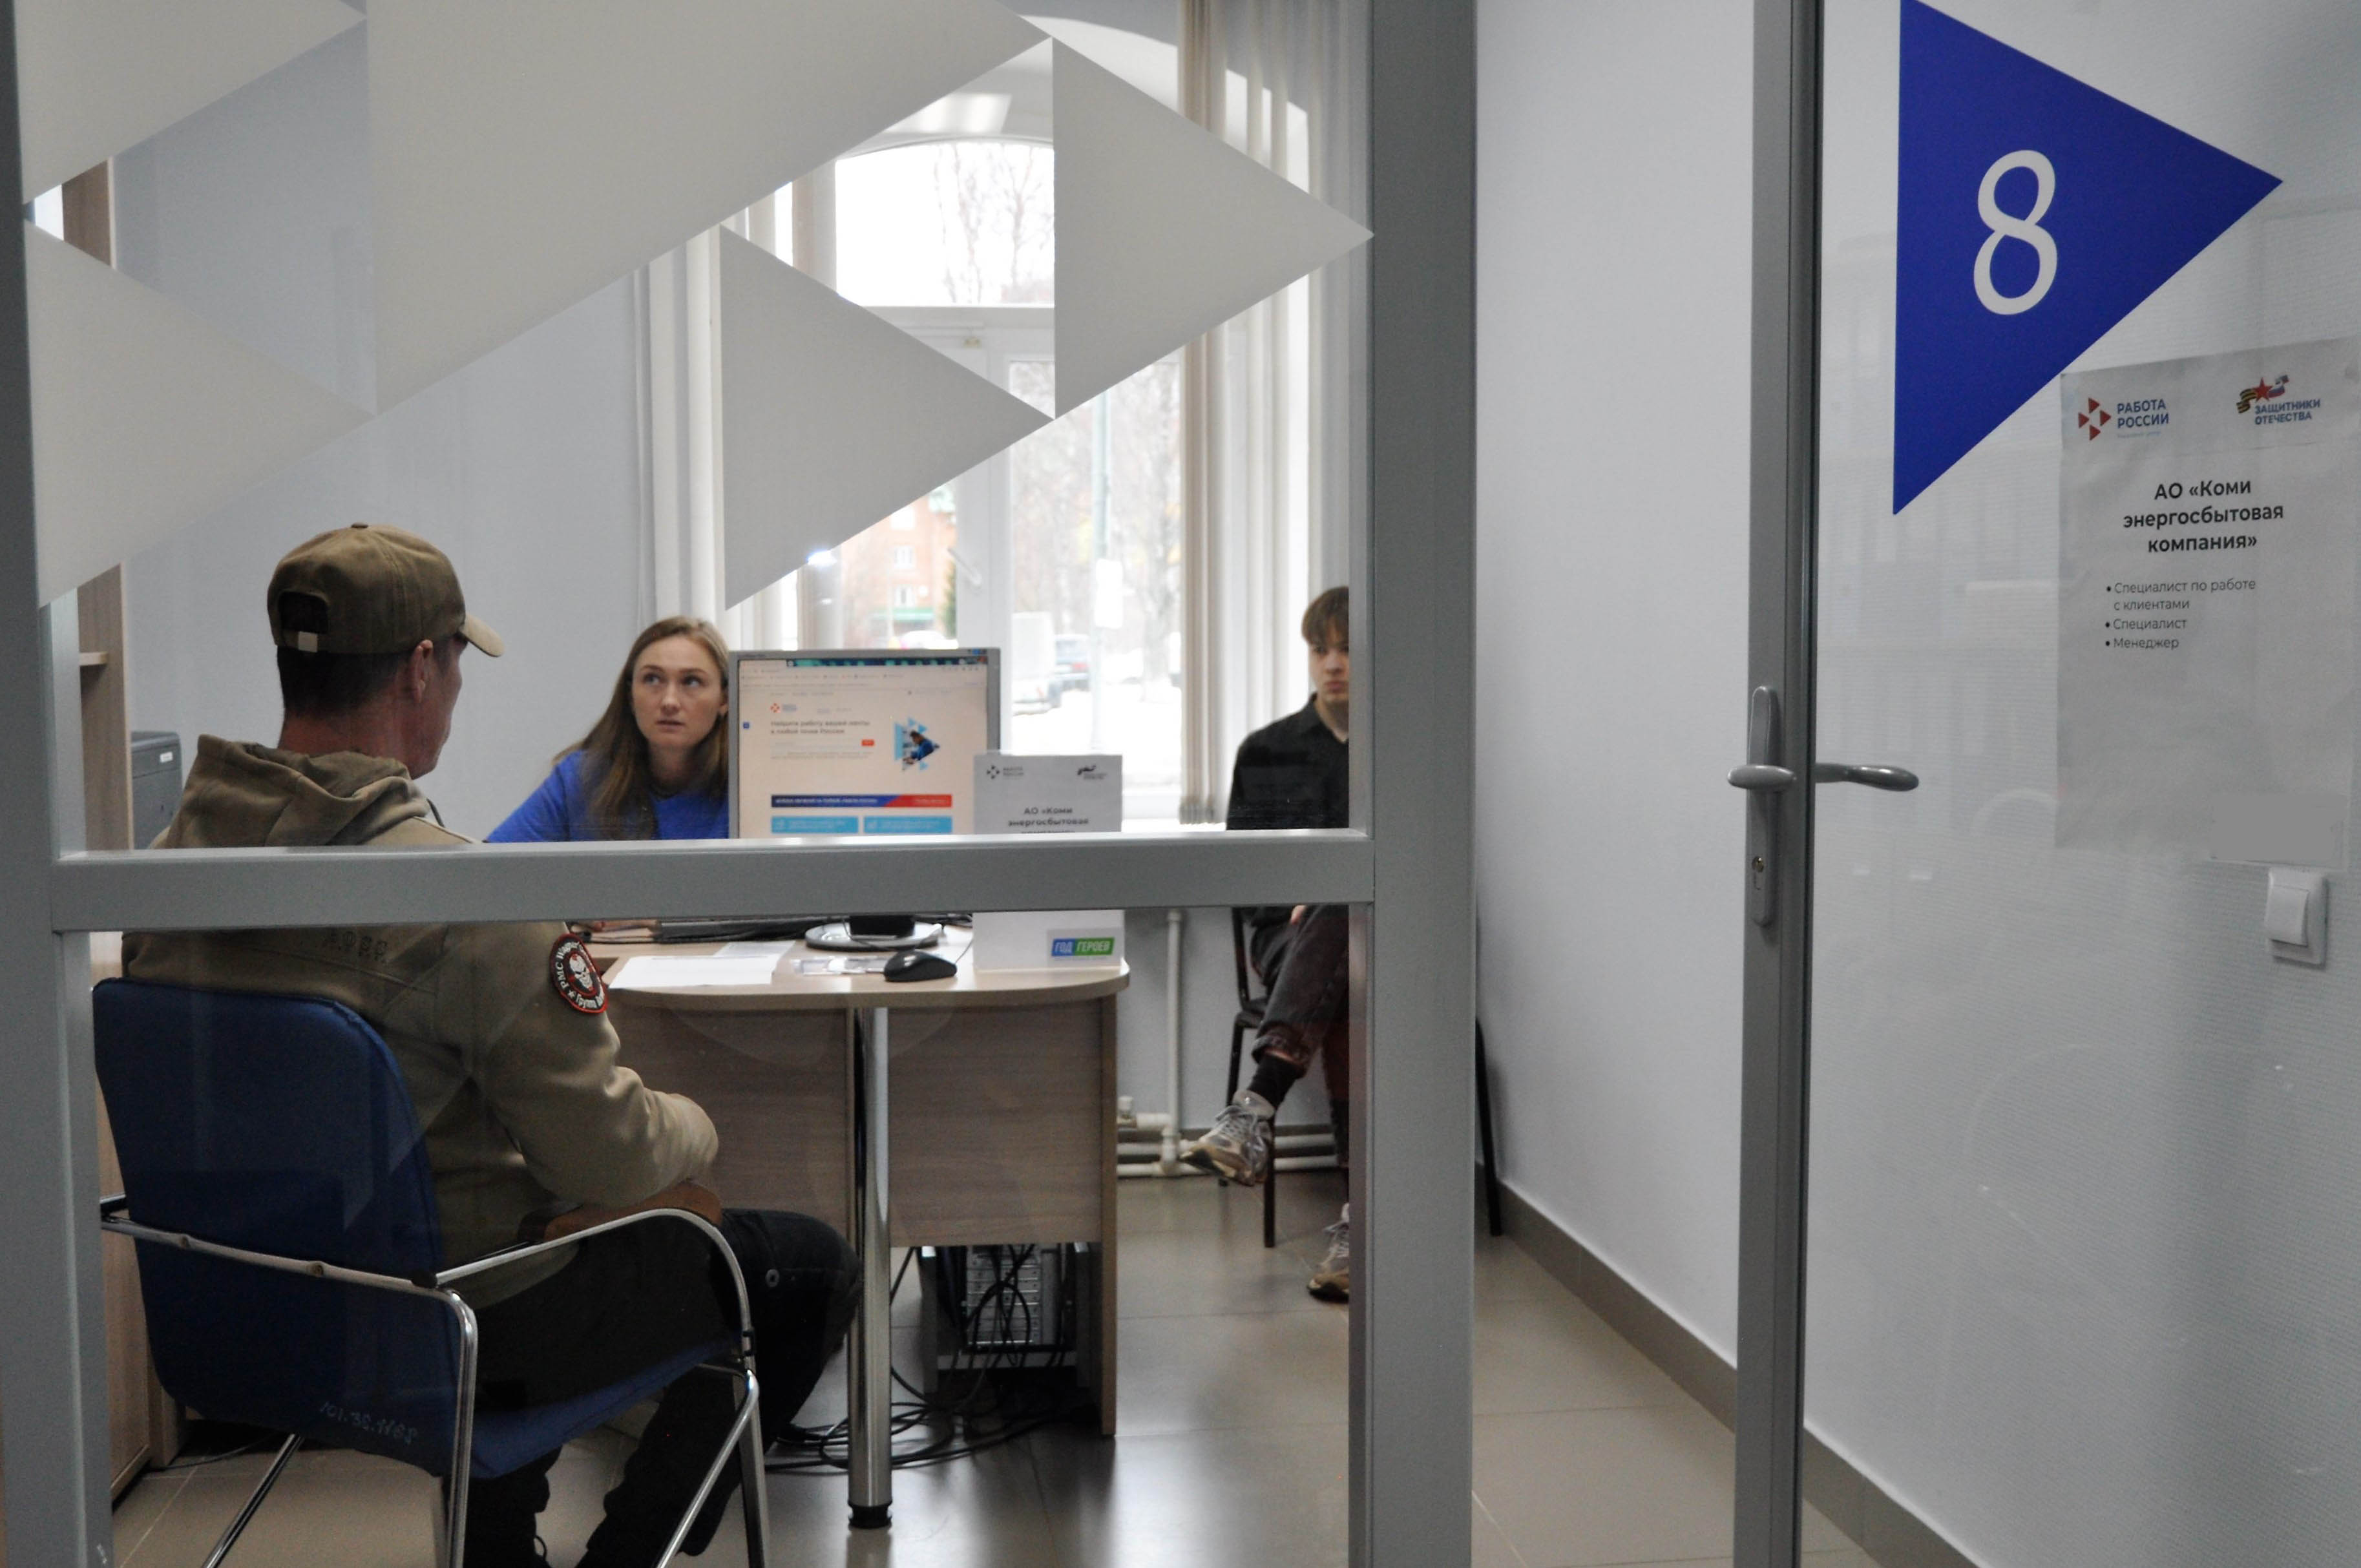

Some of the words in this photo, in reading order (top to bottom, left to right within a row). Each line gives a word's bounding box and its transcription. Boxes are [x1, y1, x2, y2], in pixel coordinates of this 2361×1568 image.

[1973, 149, 2058, 316] 8
[2117, 399, 2166, 414] РАБОТА
[2254, 398, 2321, 415] ЗАЩИТНИКИ
[2117, 413, 2169, 429] РОССИИ
[2254, 412, 2313, 426] ОТЕЧЕСТВА
[2154, 483, 2183, 500] АО
[2188, 480, 2251, 497] «Коми
[2123, 505, 2284, 530] энергосбытовая
[2148, 536, 2258, 552] компания»
[2114, 581, 2188, 594] Специалист
[2191, 581, 2207, 591] по
[2210, 578, 2256, 593] работе
[2114, 602, 2121, 611] с
[2123, 599, 2190, 611] клиентами
[2113, 618, 2187, 631] Специалист
[2114, 637, 2179, 650] Менеджер
[1008, 817, 1089, 827] энергосбытовая
[1054, 941, 1073, 954] ГОД
[555, 961, 569, 989] PMC
